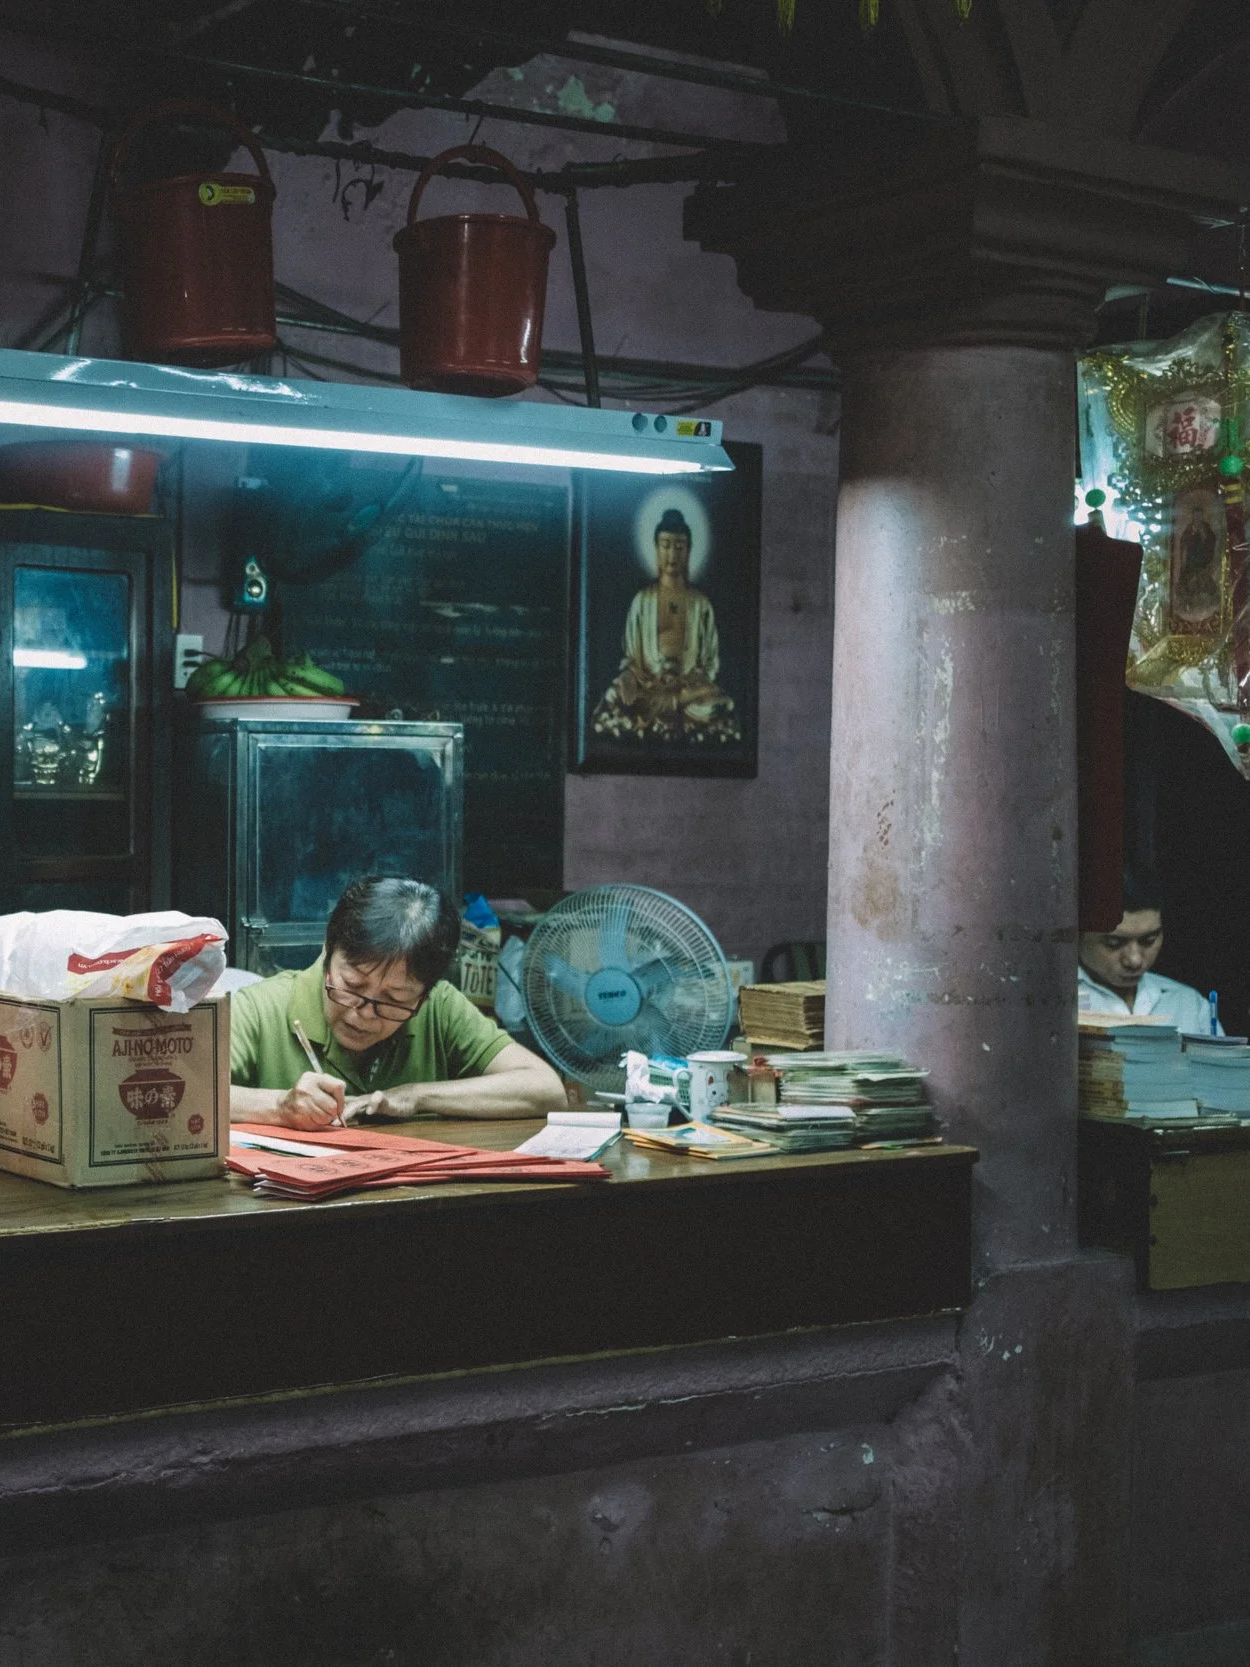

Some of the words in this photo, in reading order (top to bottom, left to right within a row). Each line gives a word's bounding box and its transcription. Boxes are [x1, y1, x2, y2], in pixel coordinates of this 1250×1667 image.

[1167, 406, 1197, 449] 福
[126, 1085, 177, 1110] 味の素
